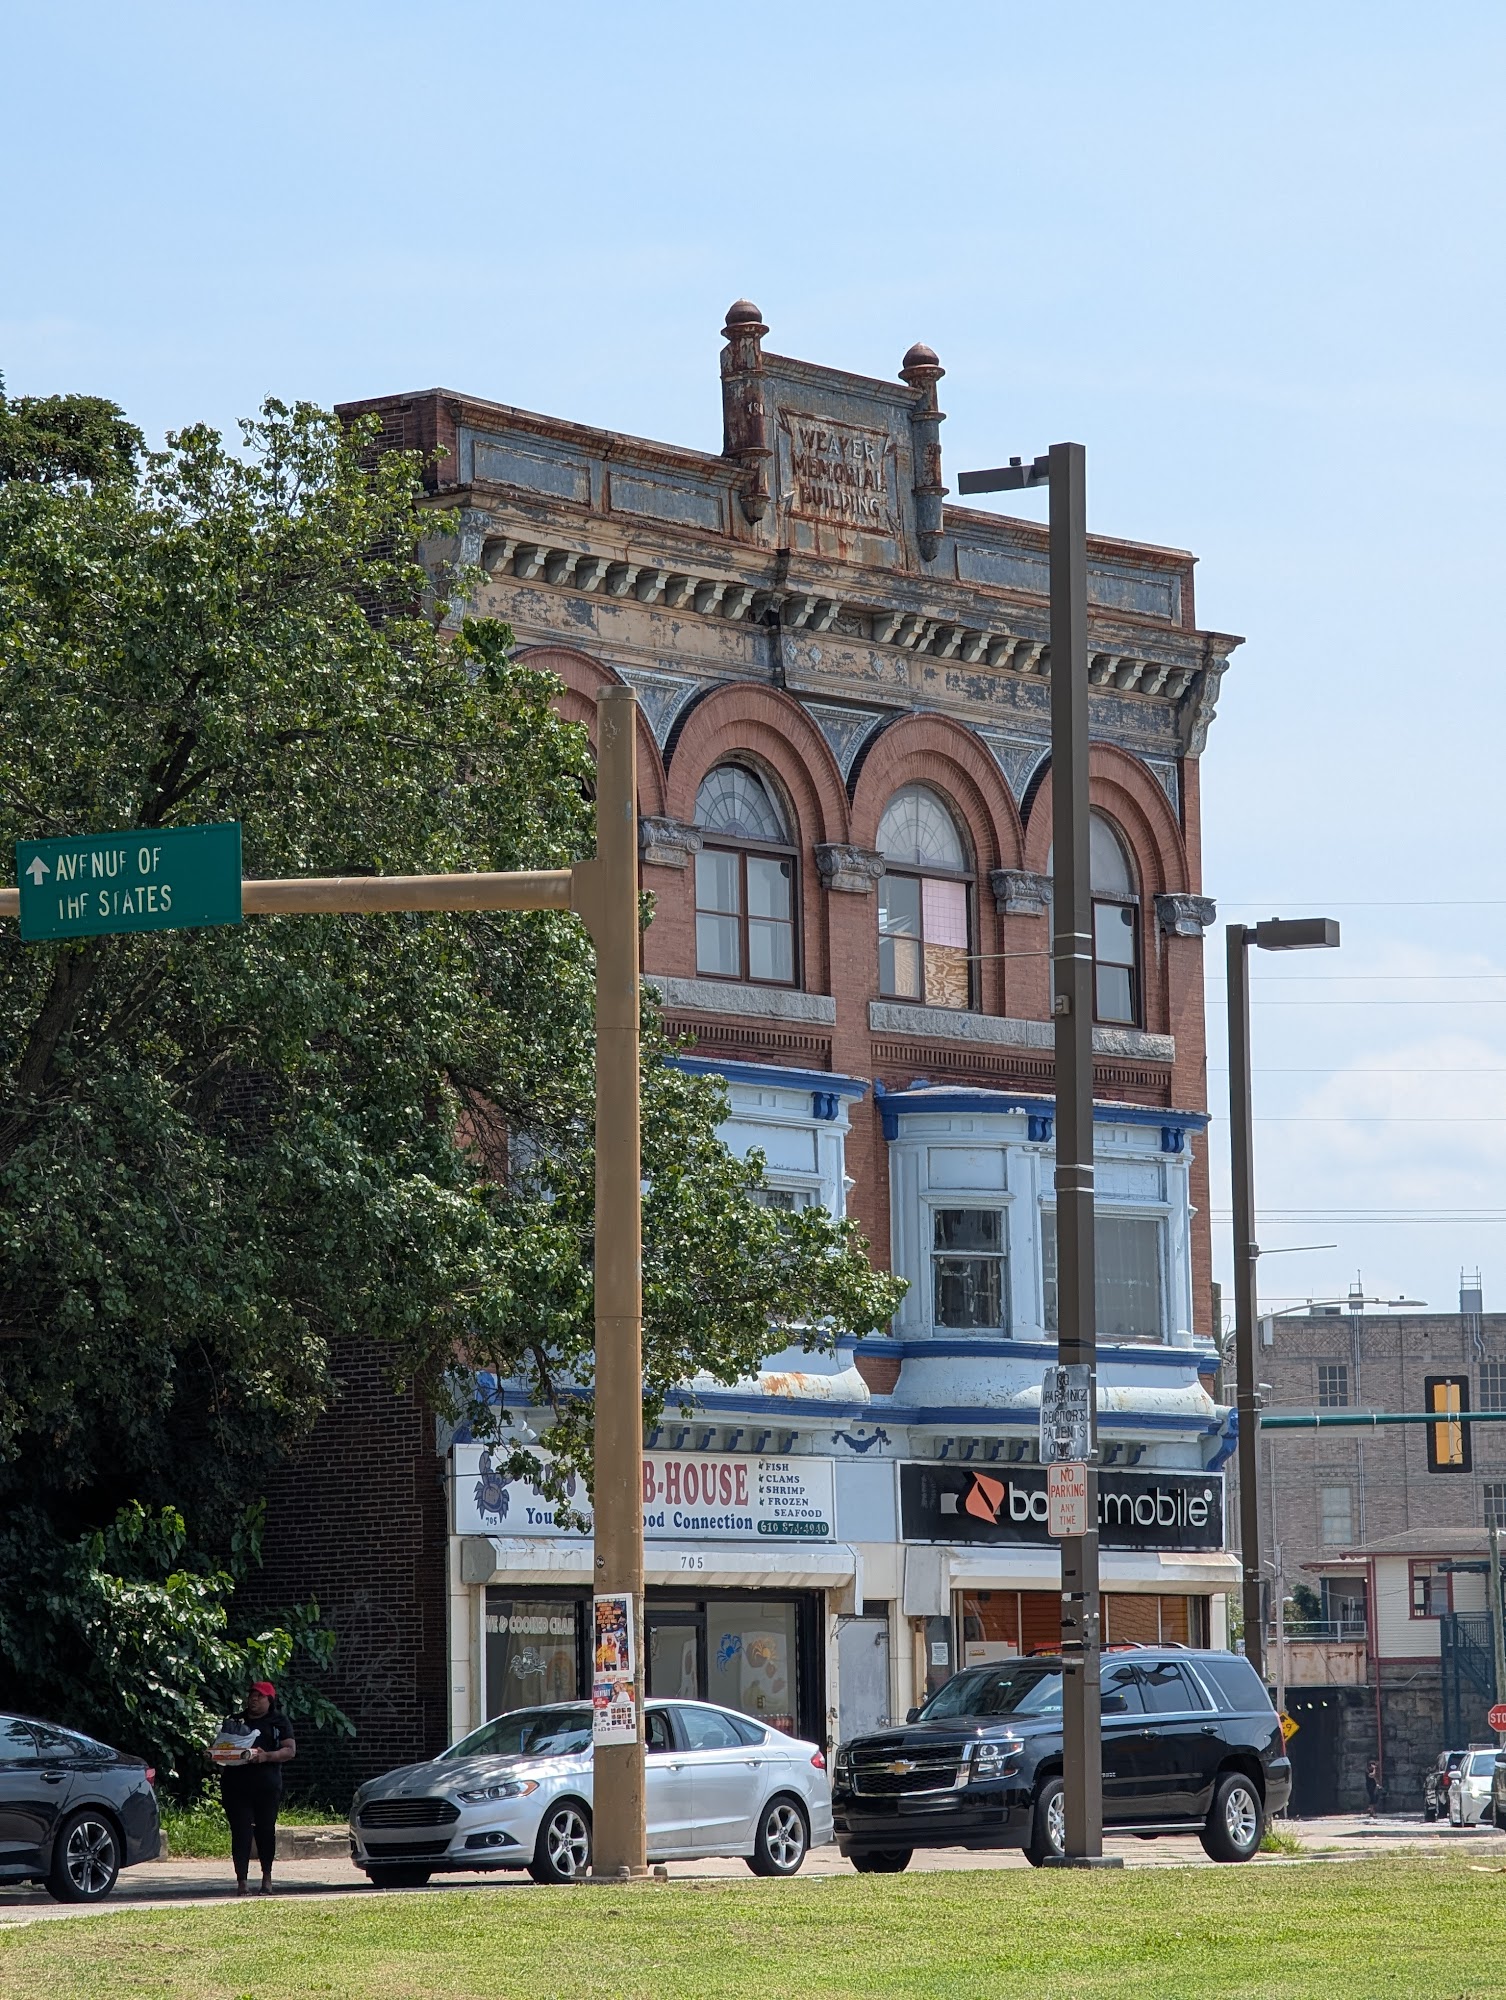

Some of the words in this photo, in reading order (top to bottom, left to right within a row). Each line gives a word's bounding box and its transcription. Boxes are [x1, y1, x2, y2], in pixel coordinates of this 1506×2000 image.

[800, 483, 880, 517] BUILDING
[138, 847, 162, 875] OF
[98, 884, 172, 917] STATES
[765, 1463, 789, 1471] FISH
[766, 1475, 800, 1483] CLAMS
[1060, 1469, 1074, 1482] NO
[642, 1461, 749, 1506] B-HOUSE
[766, 1486, 806, 1494] SHRIMP
[1051, 1484, 1085, 1498] PARKING
[768, 1497, 809, 1506] FROZEN
[1104, 1486, 1208, 1527] mobile
[774, 1509, 822, 1517] SEAFOOD
[1060, 1503, 1075, 1513] ANY
[485, 1517, 498, 1526] 705
[526, 1507, 554, 1524] You
[673, 1511, 753, 1530] Connection
[1059, 1515, 1076, 1525] TIME
[760, 1521, 779, 1532] 610
[681, 1556, 703, 1569] 705
[1490, 1712, 1506, 1724] STO
